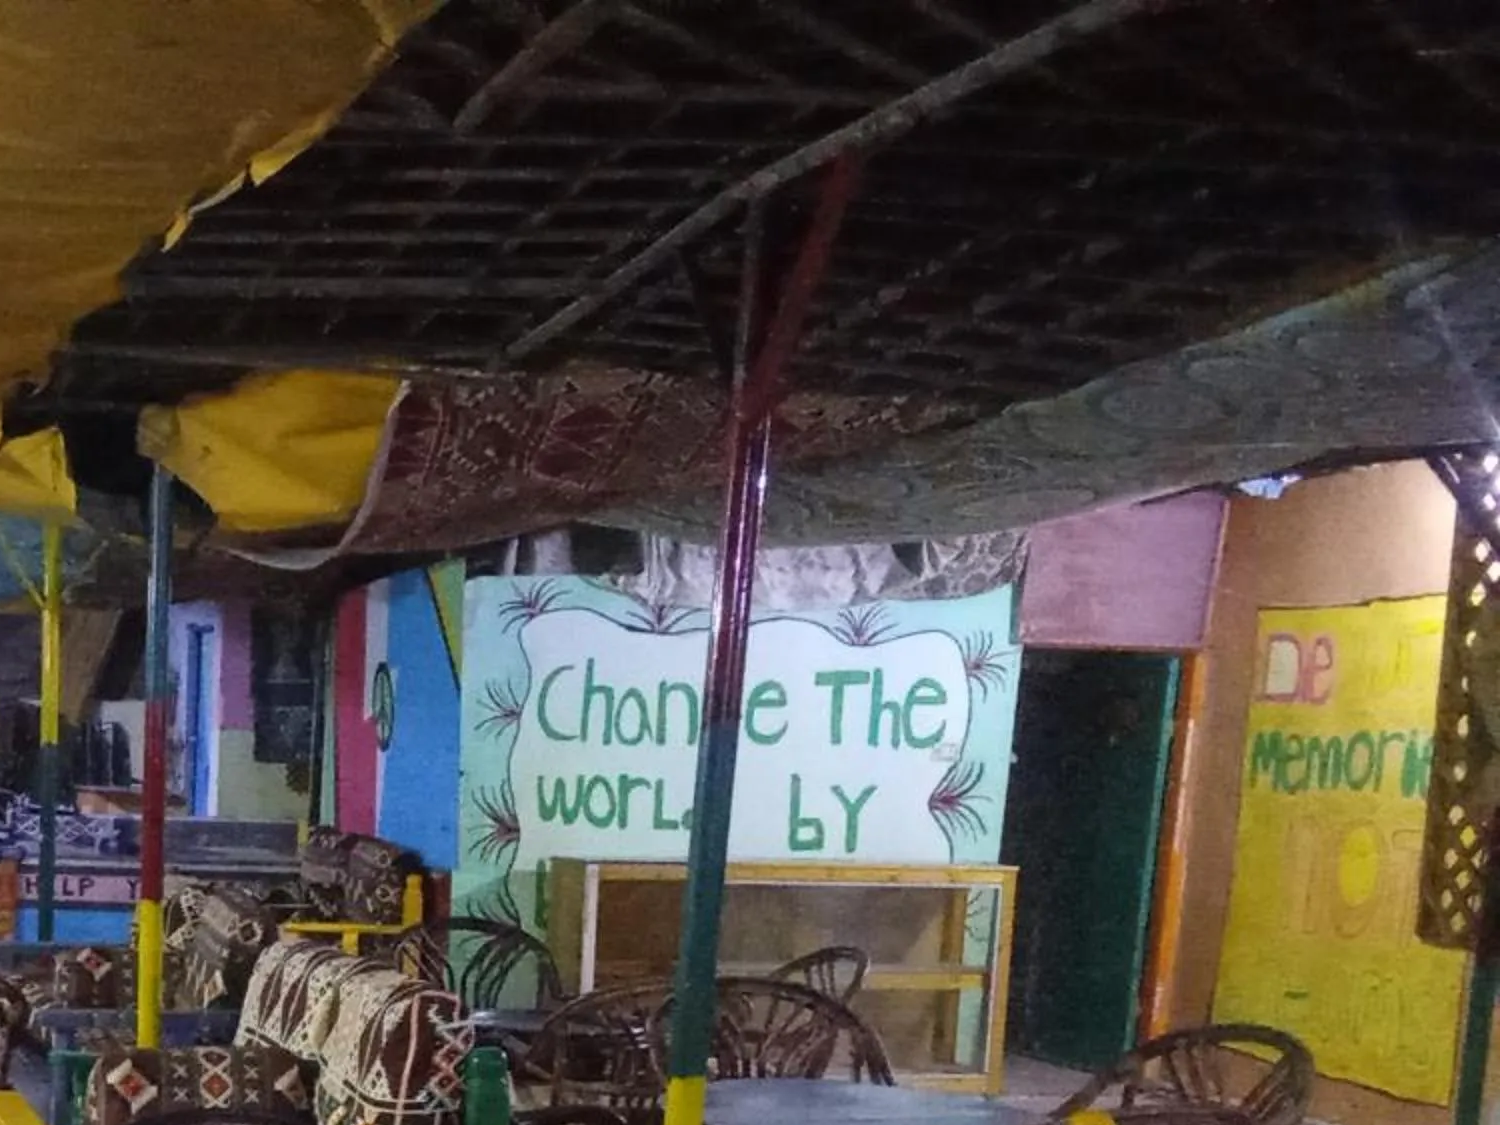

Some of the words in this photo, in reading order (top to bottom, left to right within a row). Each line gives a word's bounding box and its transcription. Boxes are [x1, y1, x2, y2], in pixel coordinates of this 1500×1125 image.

[537, 657, 788, 746] Chane
[814, 667, 949, 749] The
[536, 773, 694, 831] worL
[25, 876, 95, 897] HLP
